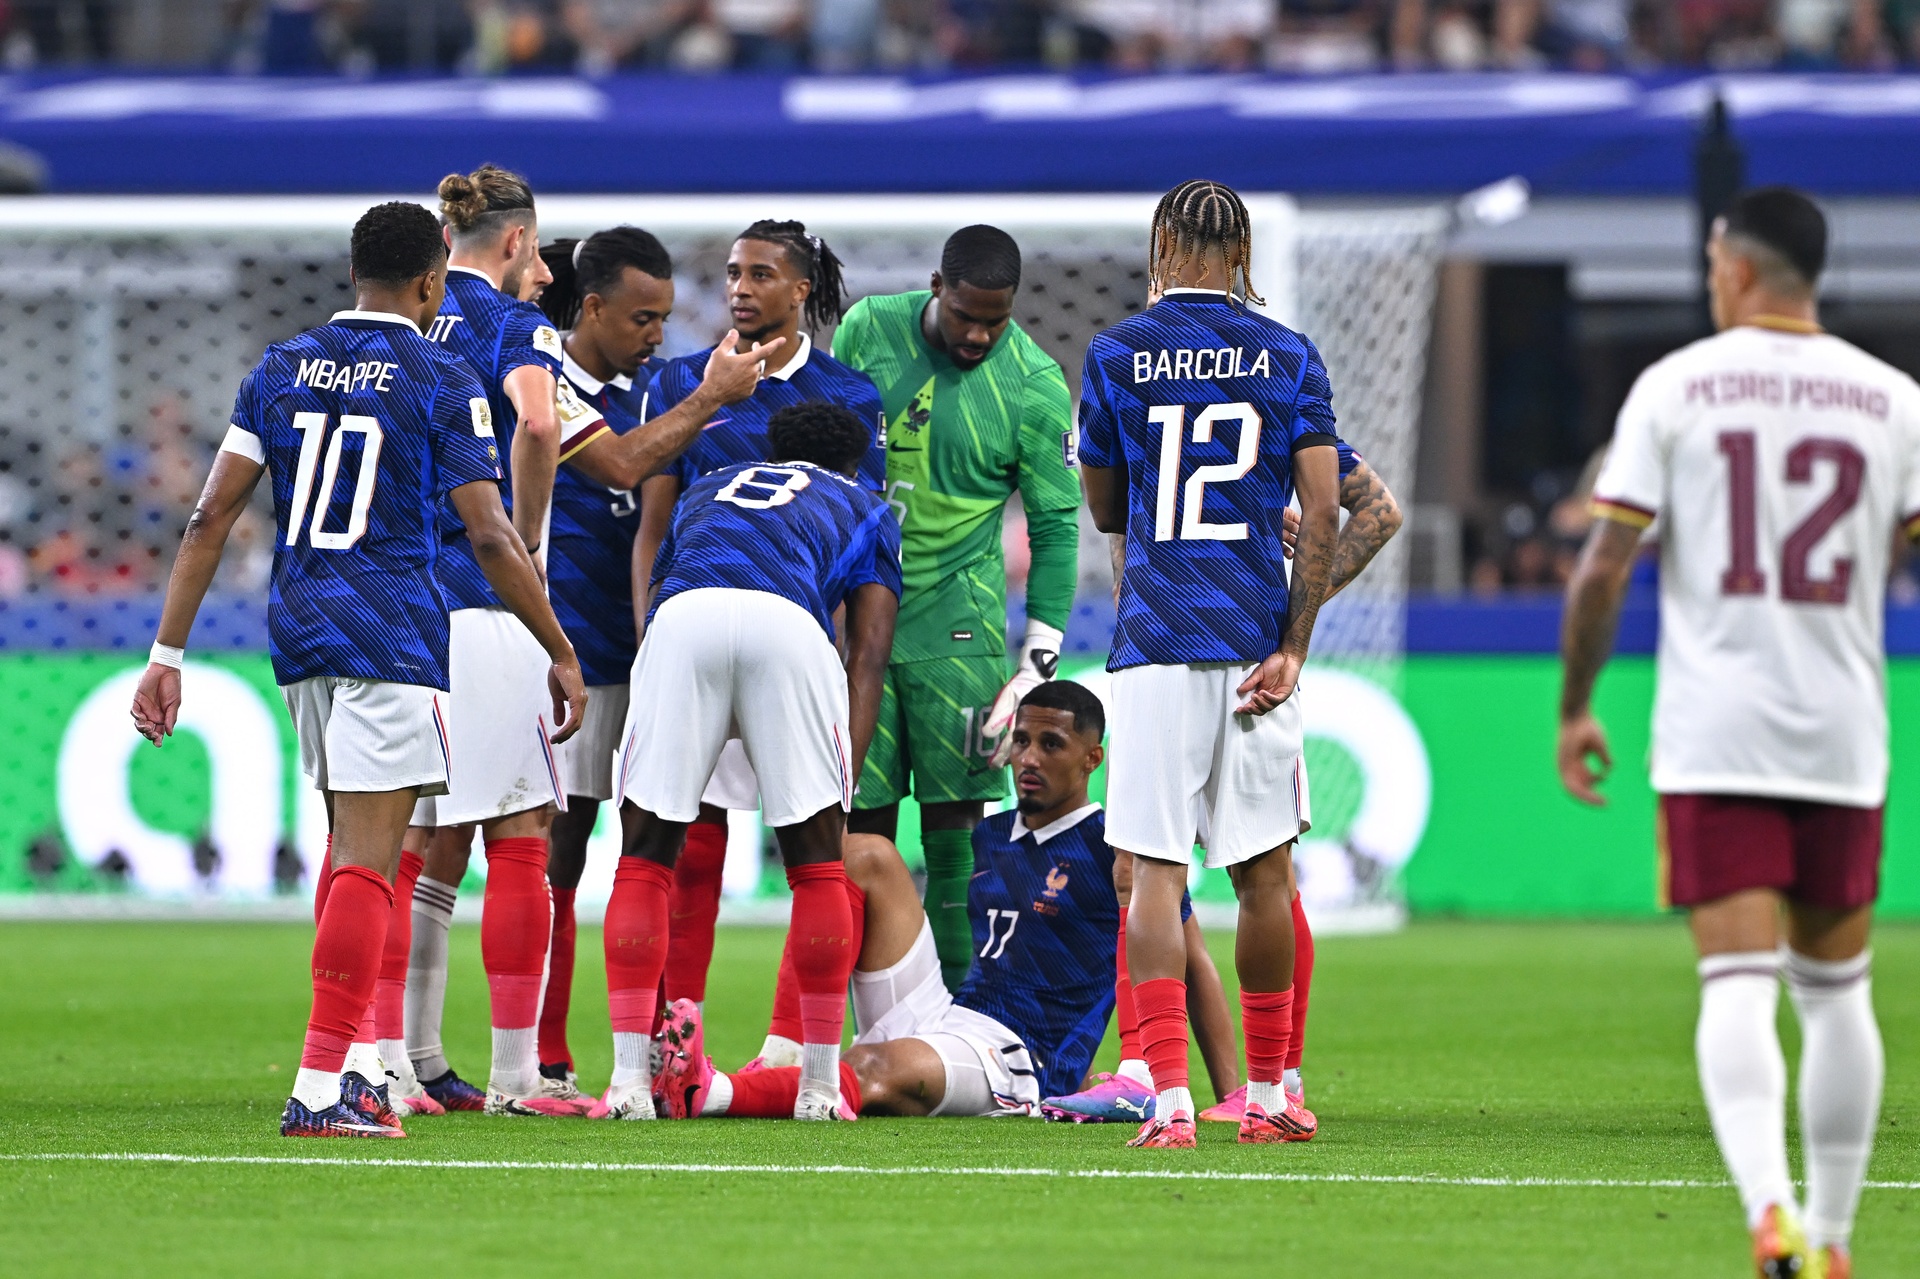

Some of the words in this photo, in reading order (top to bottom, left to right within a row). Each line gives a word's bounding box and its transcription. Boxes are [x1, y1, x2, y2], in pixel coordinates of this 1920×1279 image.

[294, 358, 399, 394] MBAPPE
[1133, 347, 1270, 384] BARCOLA
[1684, 370, 1785, 408] PEDRO
[1788, 376, 1891, 422] PORRO
[285, 411, 385, 550] 10
[713, 466, 812, 510] 8
[1147, 402, 1263, 542] 12
[1717, 428, 1867, 606] 12
[979, 908, 1020, 959] 17
